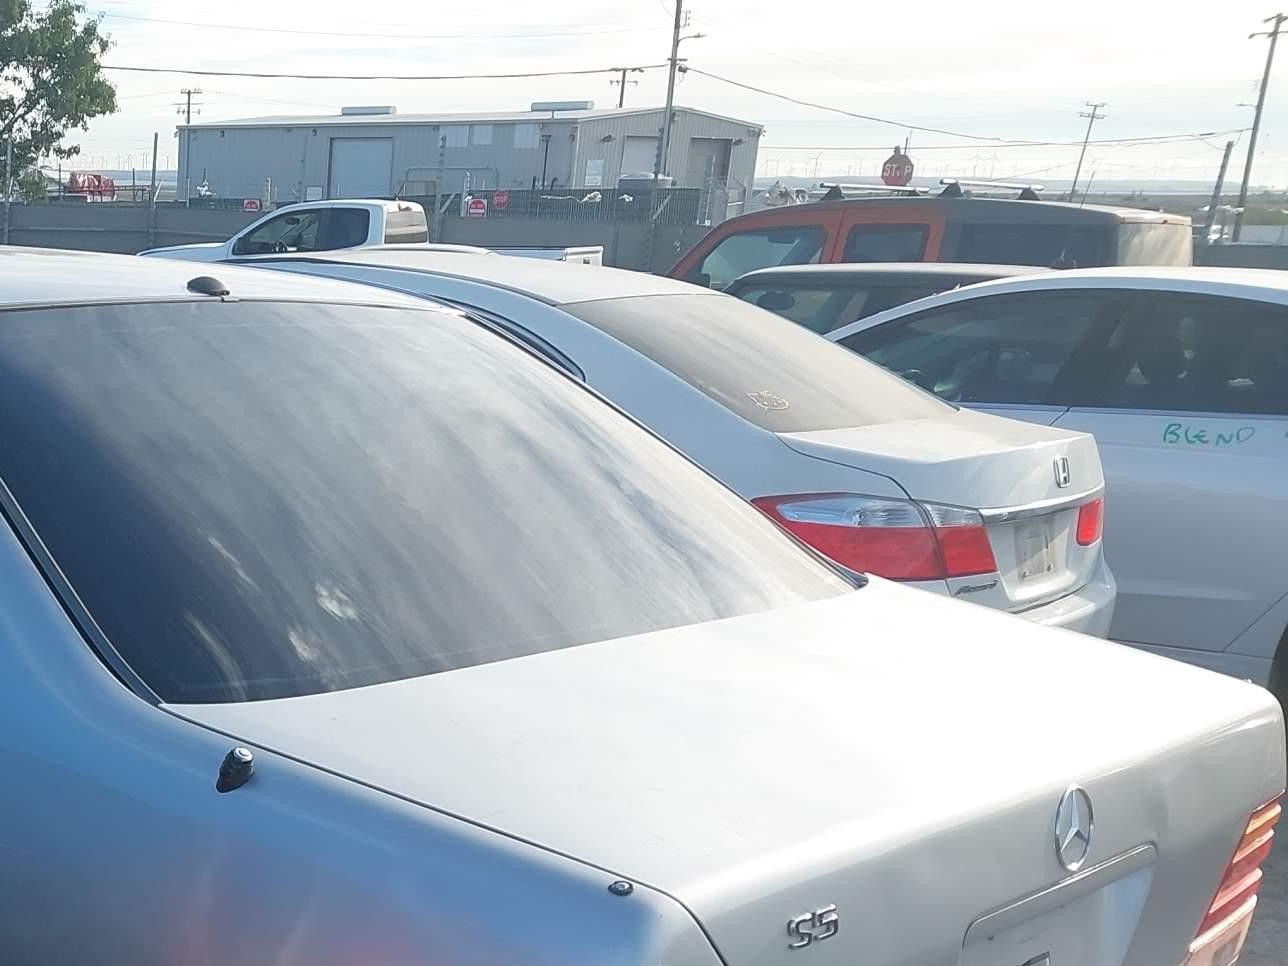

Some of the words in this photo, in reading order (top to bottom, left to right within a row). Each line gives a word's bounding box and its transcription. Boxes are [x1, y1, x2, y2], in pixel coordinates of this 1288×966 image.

[883, 163, 912, 177] STP
[1162, 422, 1256, 446] BLEND
[787, 903, 839, 951] S5
